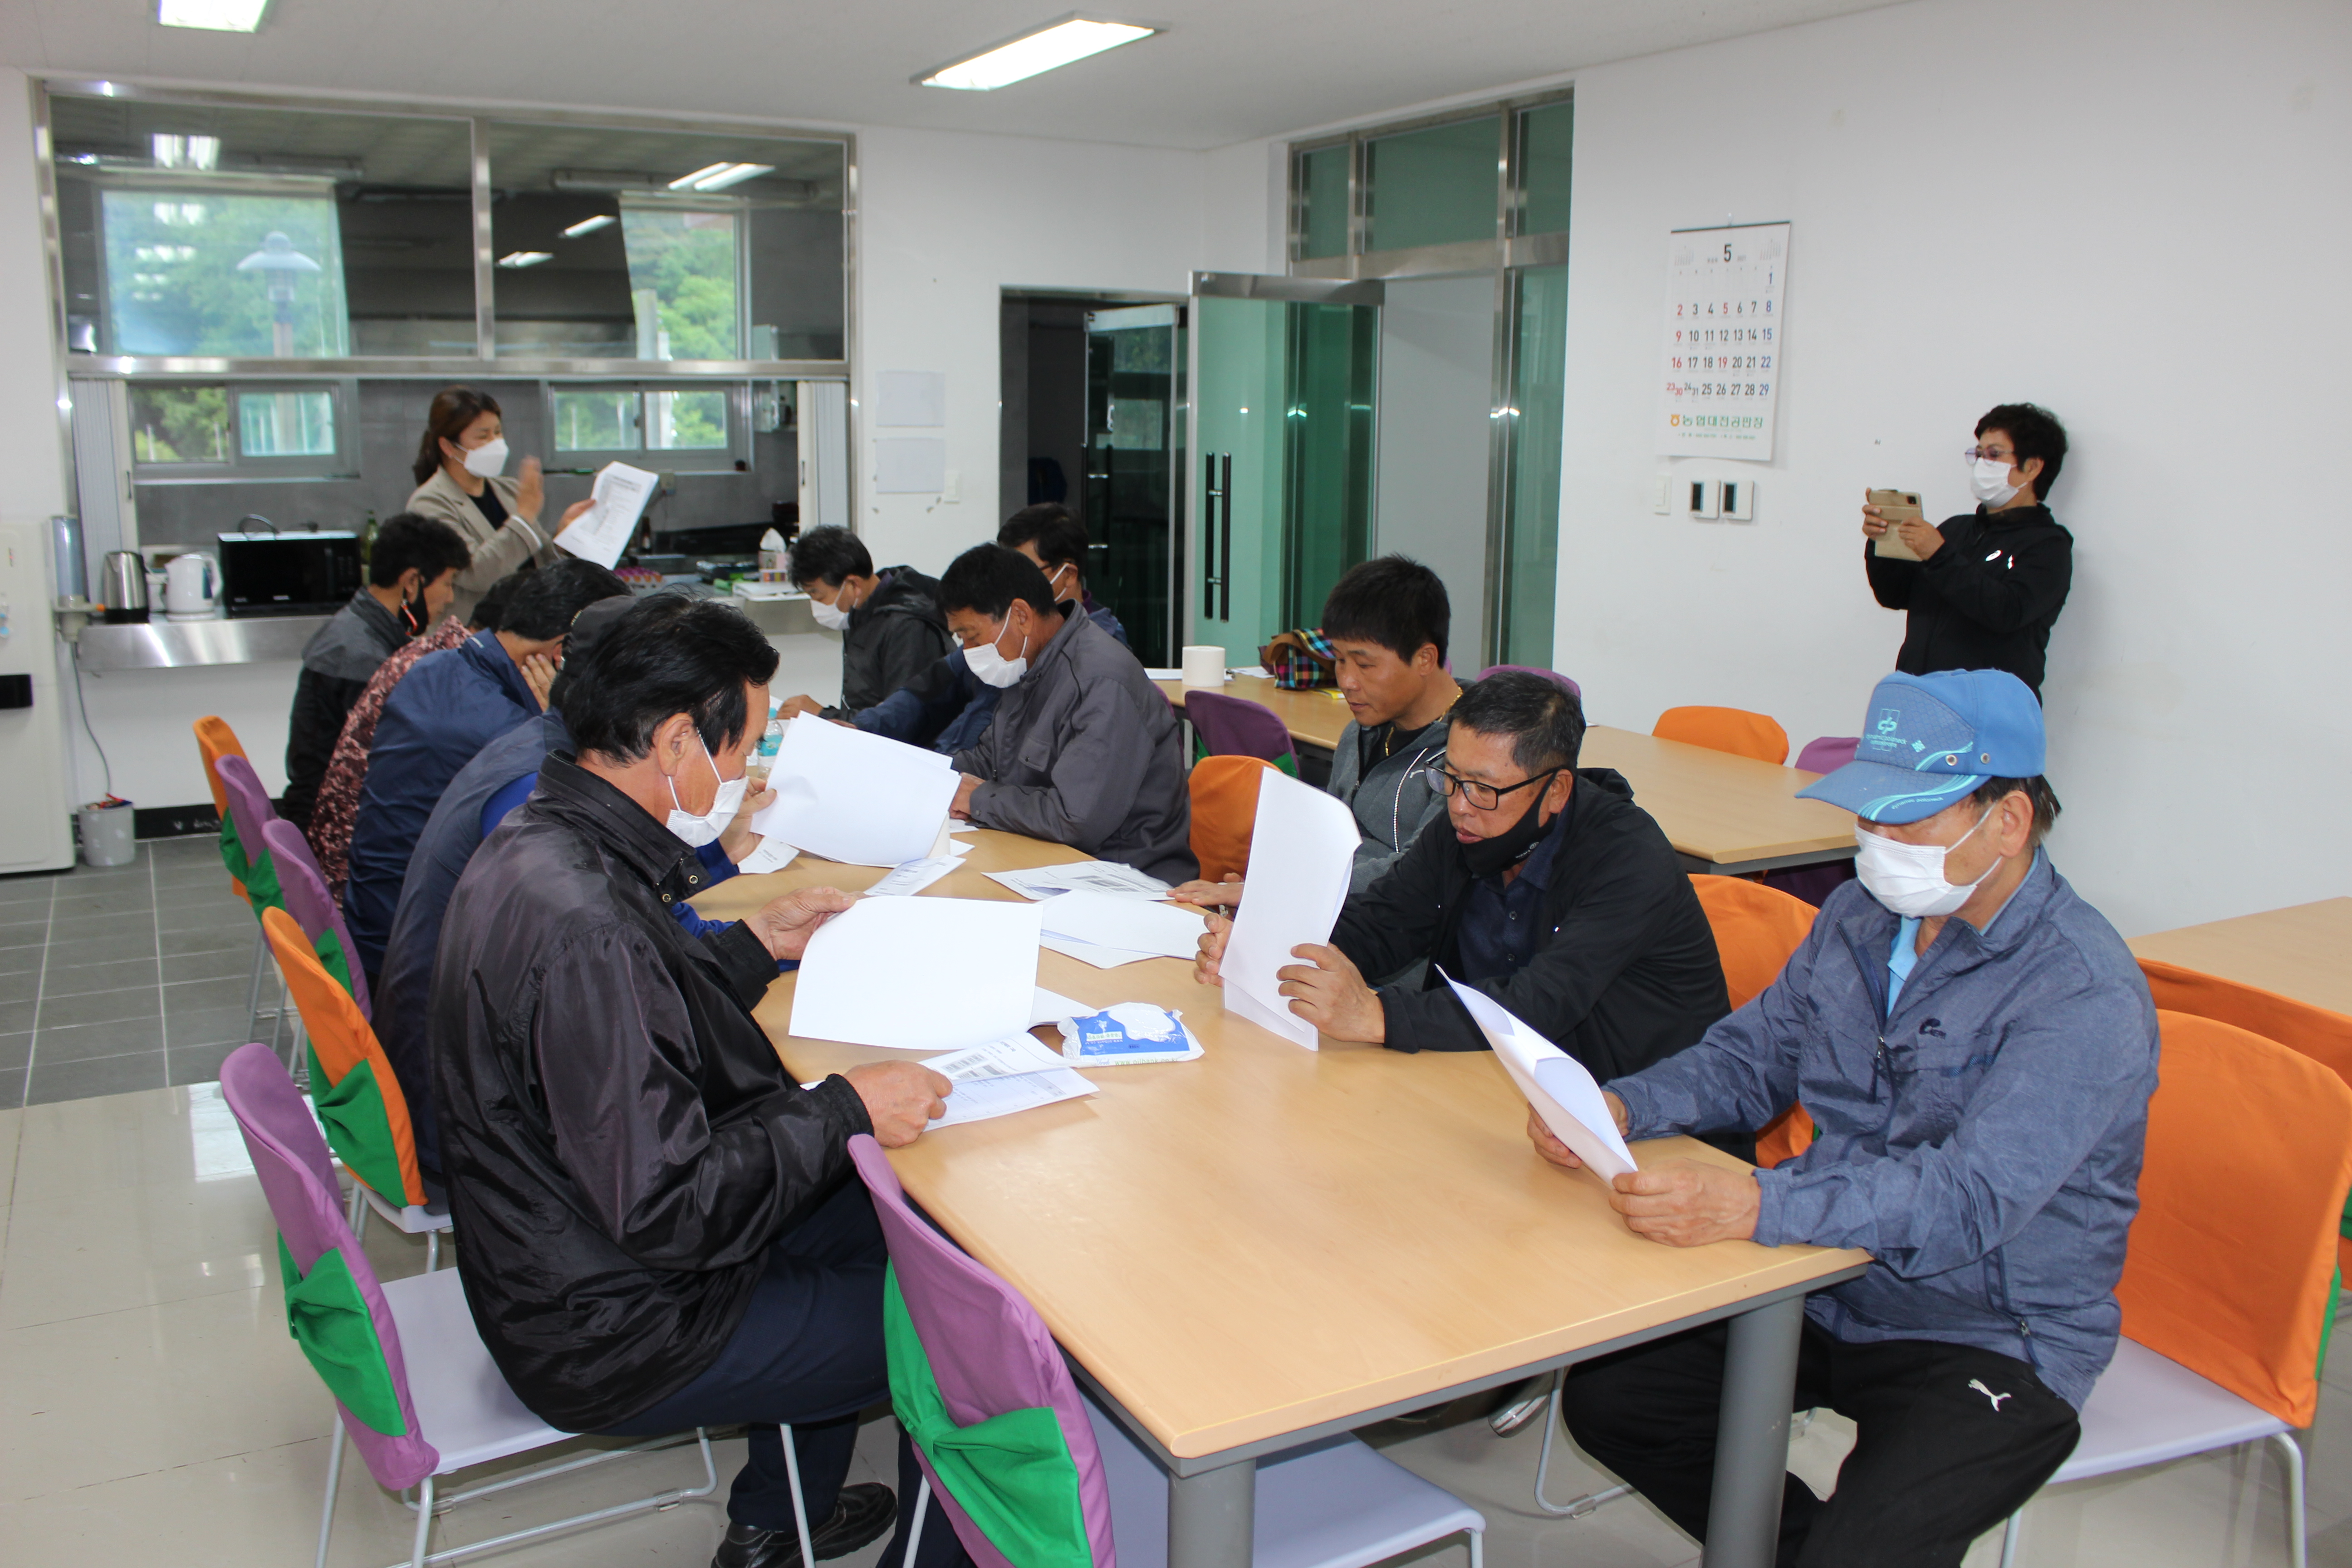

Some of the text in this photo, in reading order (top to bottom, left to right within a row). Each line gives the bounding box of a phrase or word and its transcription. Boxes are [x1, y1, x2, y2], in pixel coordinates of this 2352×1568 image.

[1724, 243, 1732, 263] 5
[1769, 272, 1773, 284] 1
[1677, 300, 1772, 316] 2 3 4 5 6 7 8
[1676, 328, 1772, 342] 9 10 11 12 13 14 15
[1671, 356, 1771, 368] 16 17 18 19 20 21 22
[1666, 382, 1769, 396] 23 30 24 31 25 26 27 28 29
